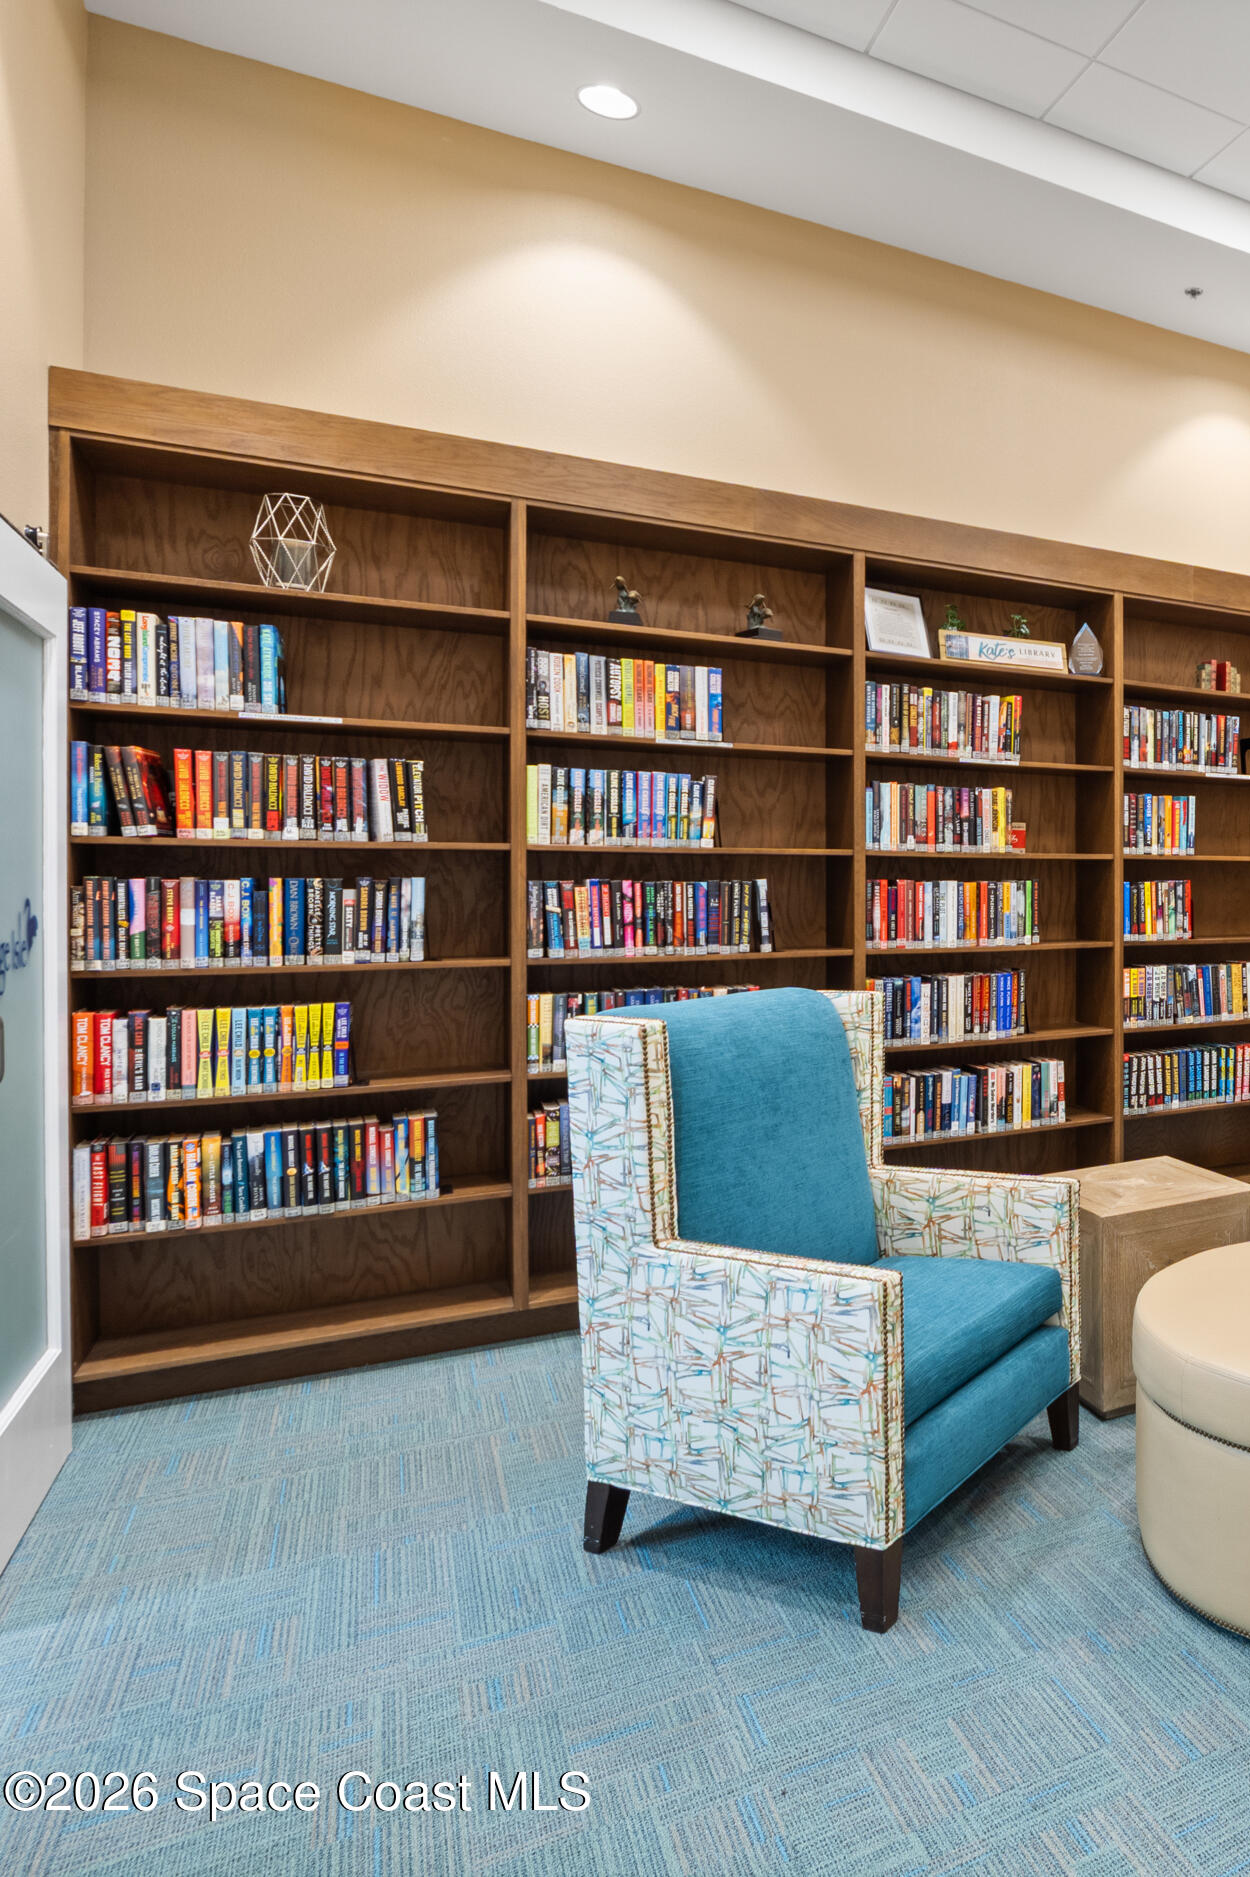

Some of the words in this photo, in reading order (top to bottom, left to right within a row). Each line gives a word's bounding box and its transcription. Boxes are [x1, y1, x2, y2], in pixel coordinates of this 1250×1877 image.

[978, 641, 1016, 661] Kate's
[1018, 649, 1056, 659] LIBRARY
[538, 695, 549, 719] HOST
